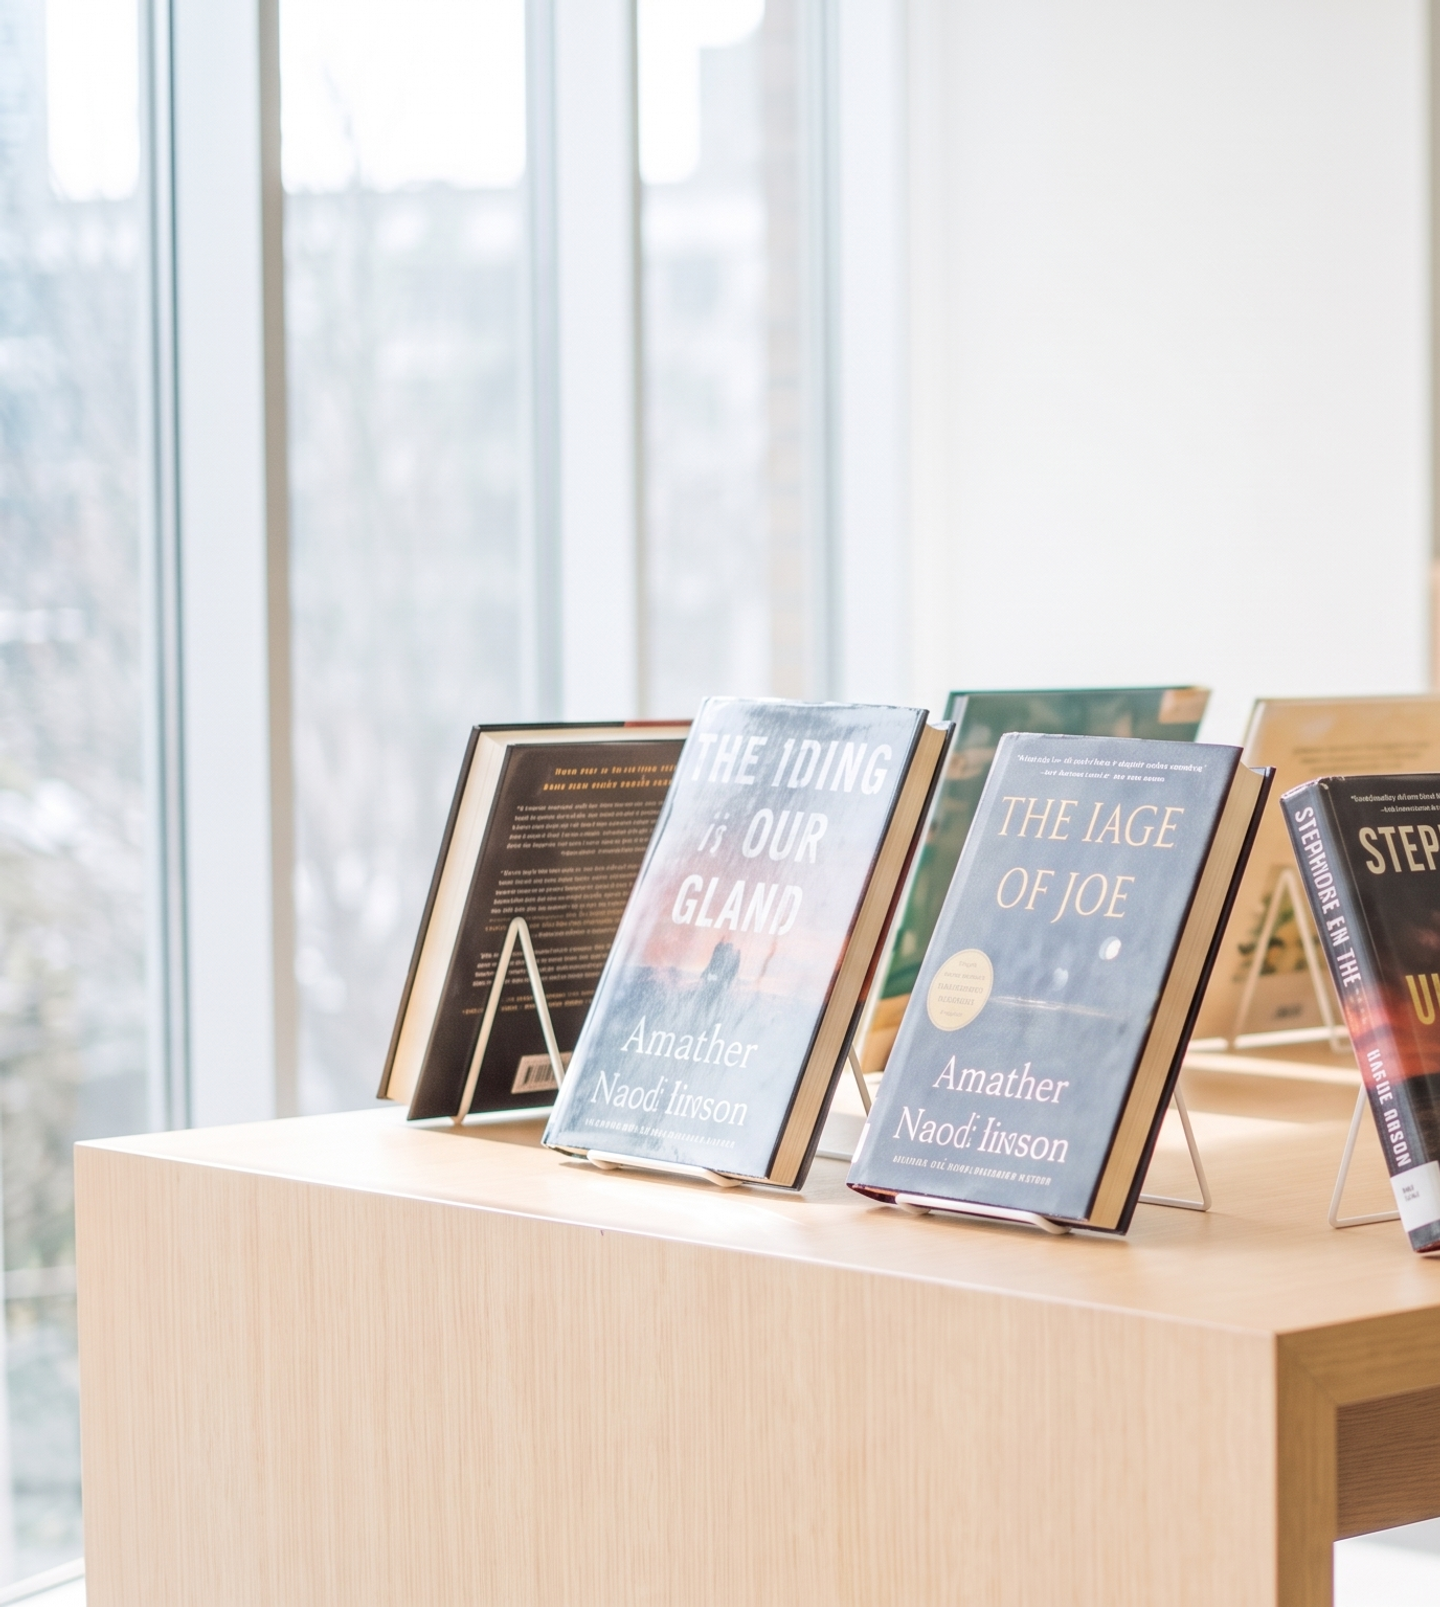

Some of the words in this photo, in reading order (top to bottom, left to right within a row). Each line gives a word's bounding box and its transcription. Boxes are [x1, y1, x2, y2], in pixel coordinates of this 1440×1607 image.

[691, 733, 768, 786] THE
[742, 808, 829, 864] OUR
[998, 796, 1078, 841] THE
[1081, 802, 1185, 848] IAGE
[671, 874, 803, 936] GLAND
[997, 867, 1055, 910] OF
[1050, 872, 1136, 924] JOE
[1336, 947, 1362, 988] THE
[620, 1015, 759, 1068] Amather
[932, 1055, 1070, 1104] Amather
